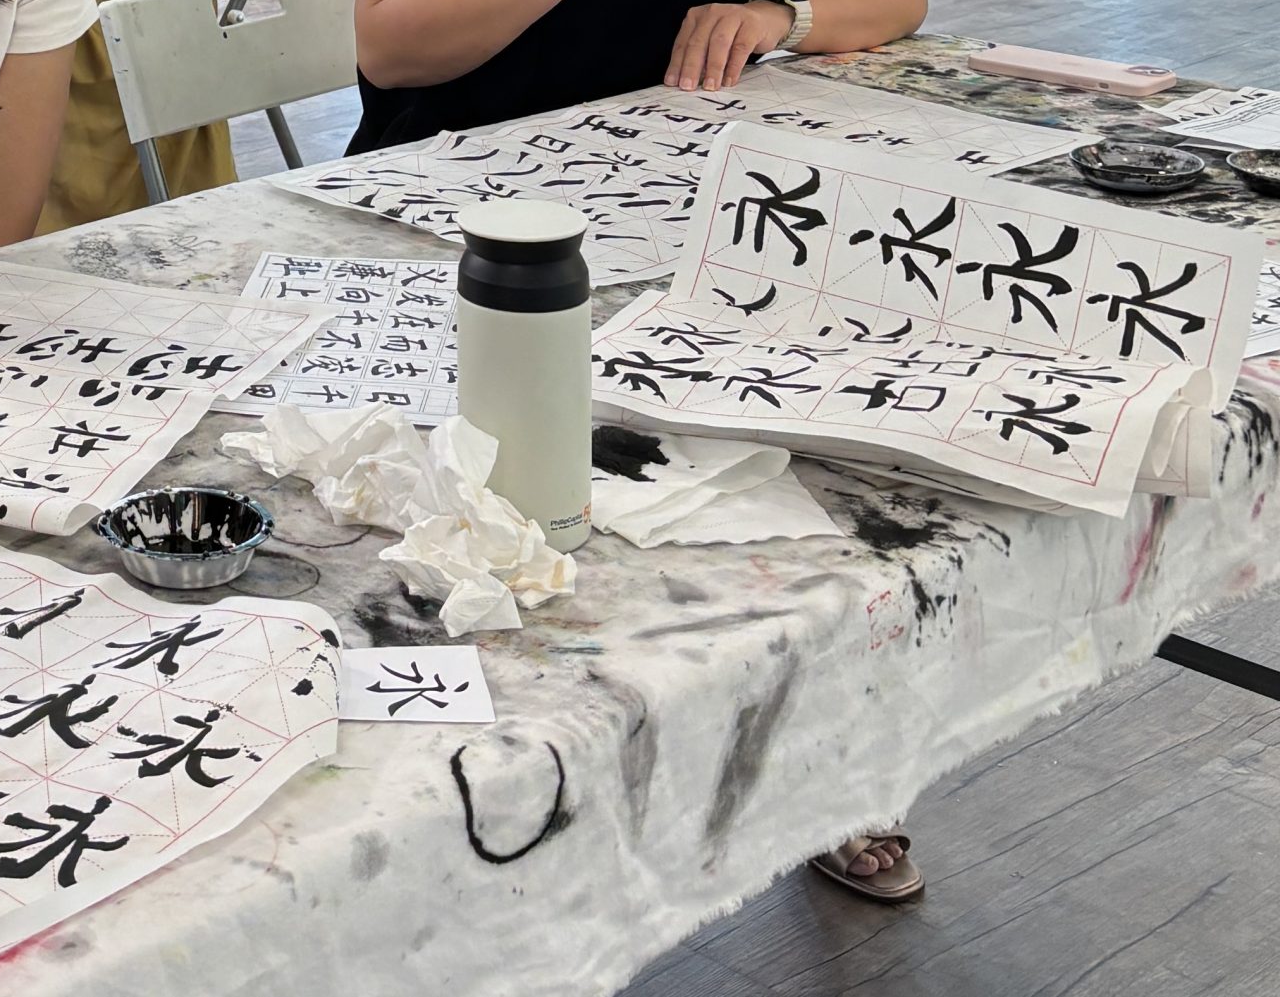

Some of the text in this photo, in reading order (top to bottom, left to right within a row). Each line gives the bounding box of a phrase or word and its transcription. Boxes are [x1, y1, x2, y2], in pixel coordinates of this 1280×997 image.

[720, 165, 828, 267] 永
[849, 197, 956, 302] 永
[957, 222, 1080, 335] 永
[1087, 260, 1206, 362] 永
[722, 365, 822, 409] 永
[972, 392, 1093, 456] 永
[366, 660, 470, 717] 永
[109, 708, 241, 788] 永
